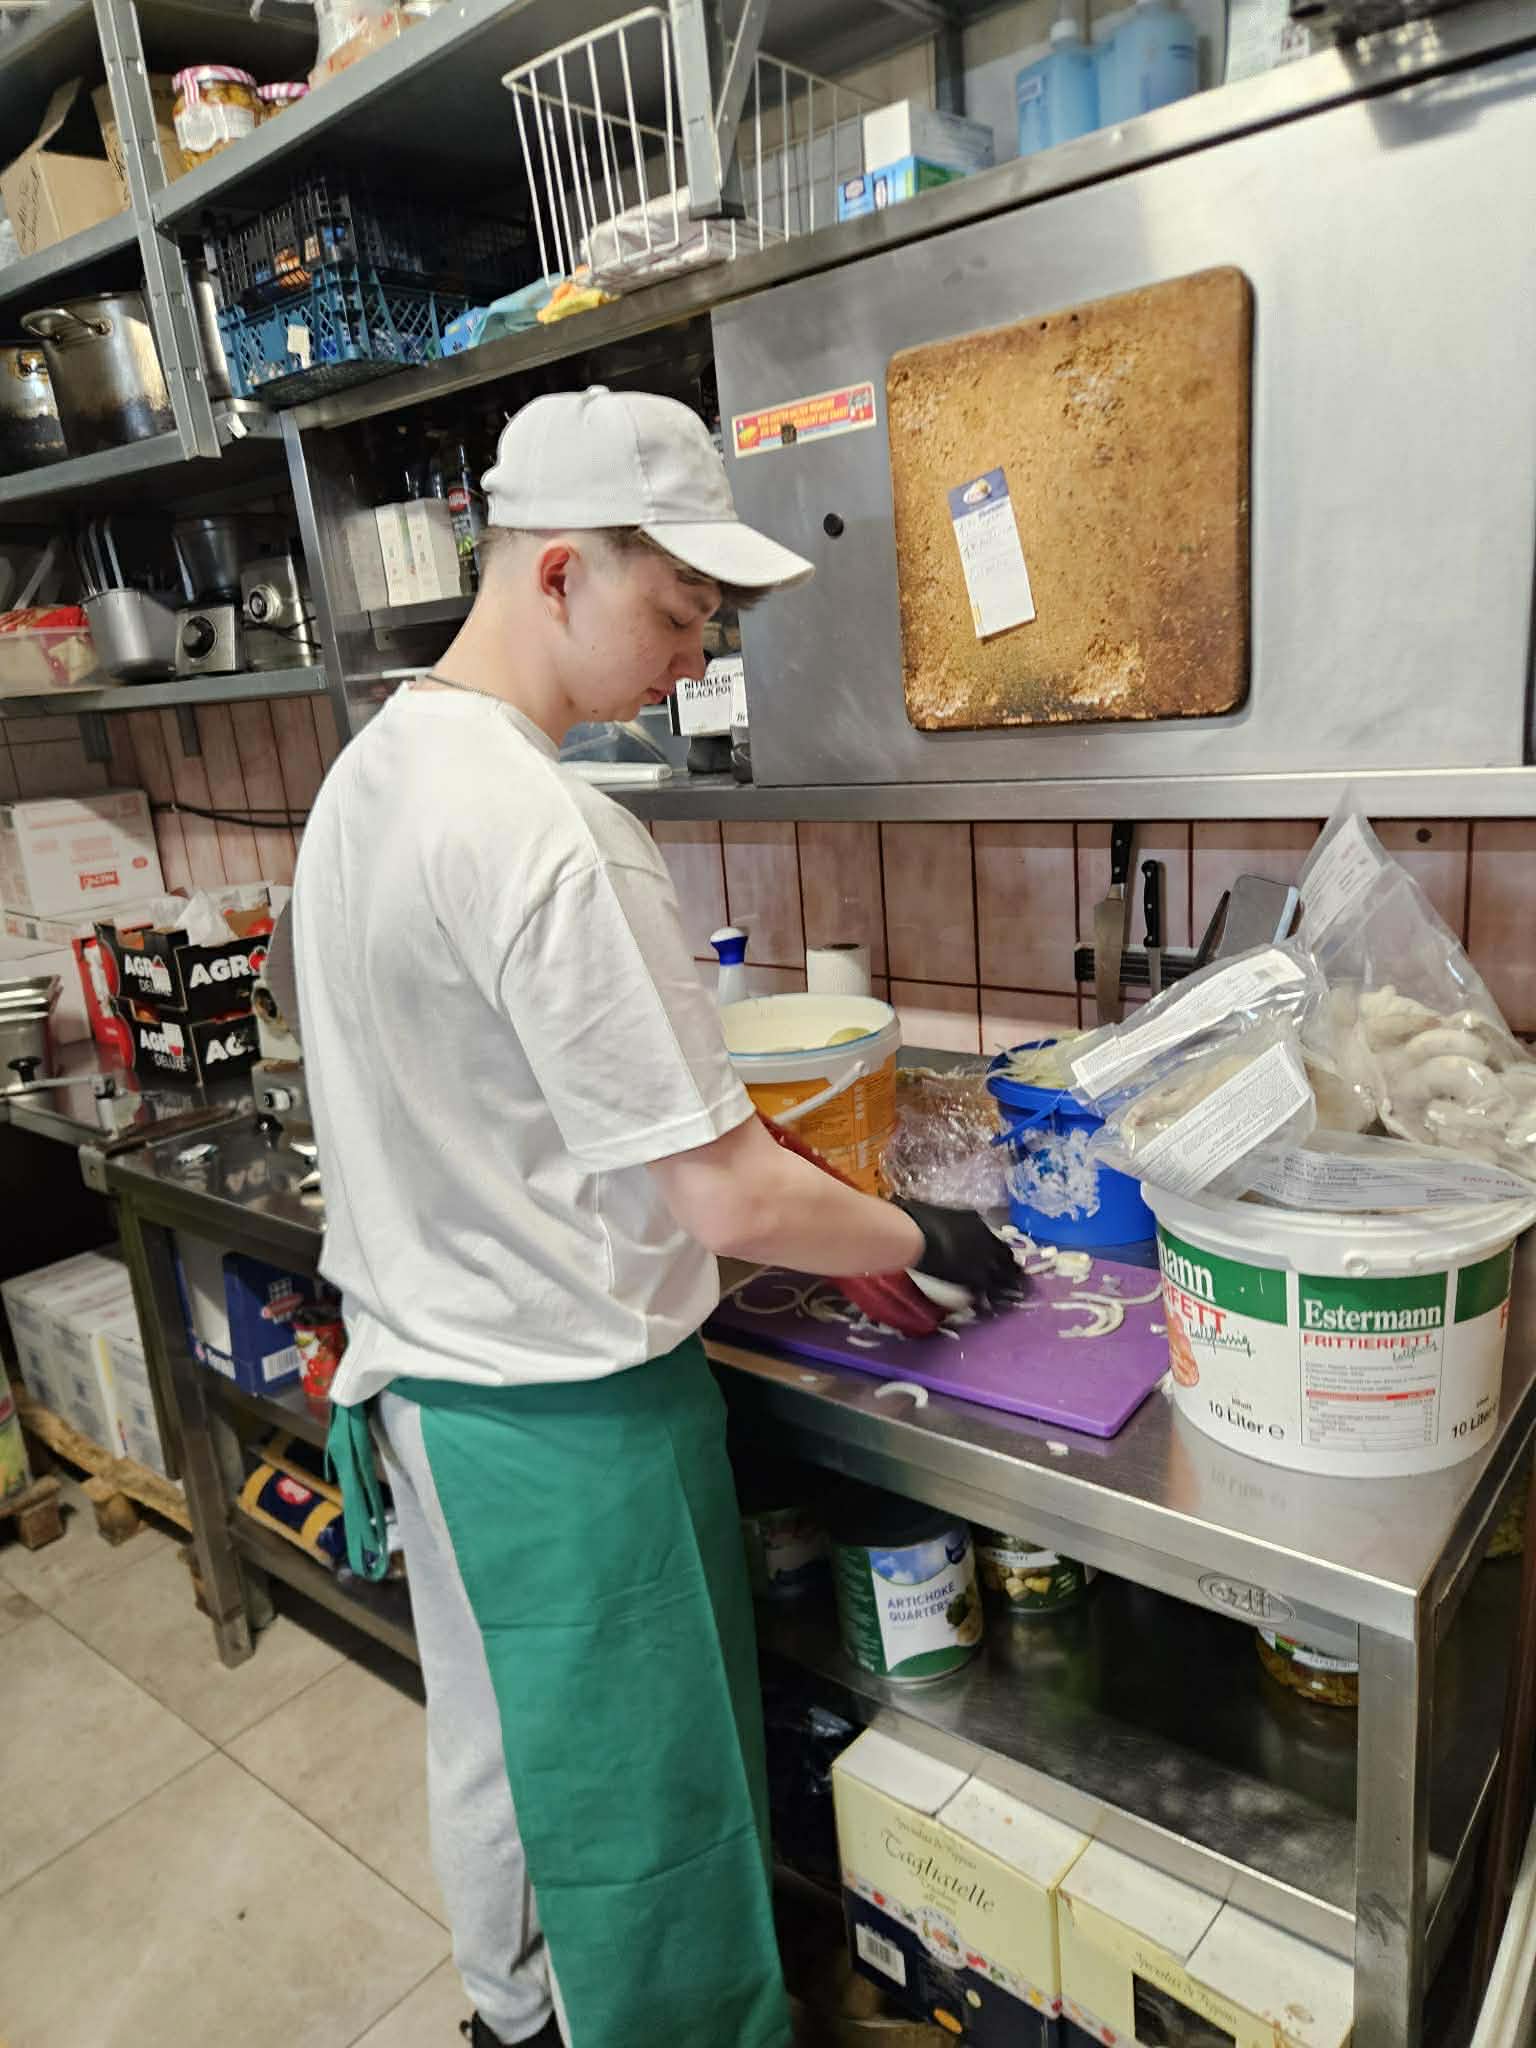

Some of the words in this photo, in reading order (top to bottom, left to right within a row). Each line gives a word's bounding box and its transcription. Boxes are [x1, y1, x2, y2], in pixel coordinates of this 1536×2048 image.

[686, 687, 714, 701] BLACK
[1303, 1298, 1442, 1332] Estermann
[1303, 1333, 1433, 1350] FRITTIERFETT
[1208, 1399, 1224, 1419] 10
[1227, 1408, 1265, 1435] Liter
[1452, 1422, 1467, 1439] 10
[887, 1582, 956, 1610] ARTICHOKE
[889, 1599, 953, 1623] QUARTERS
[880, 1829, 996, 1913] Tagliatelle
